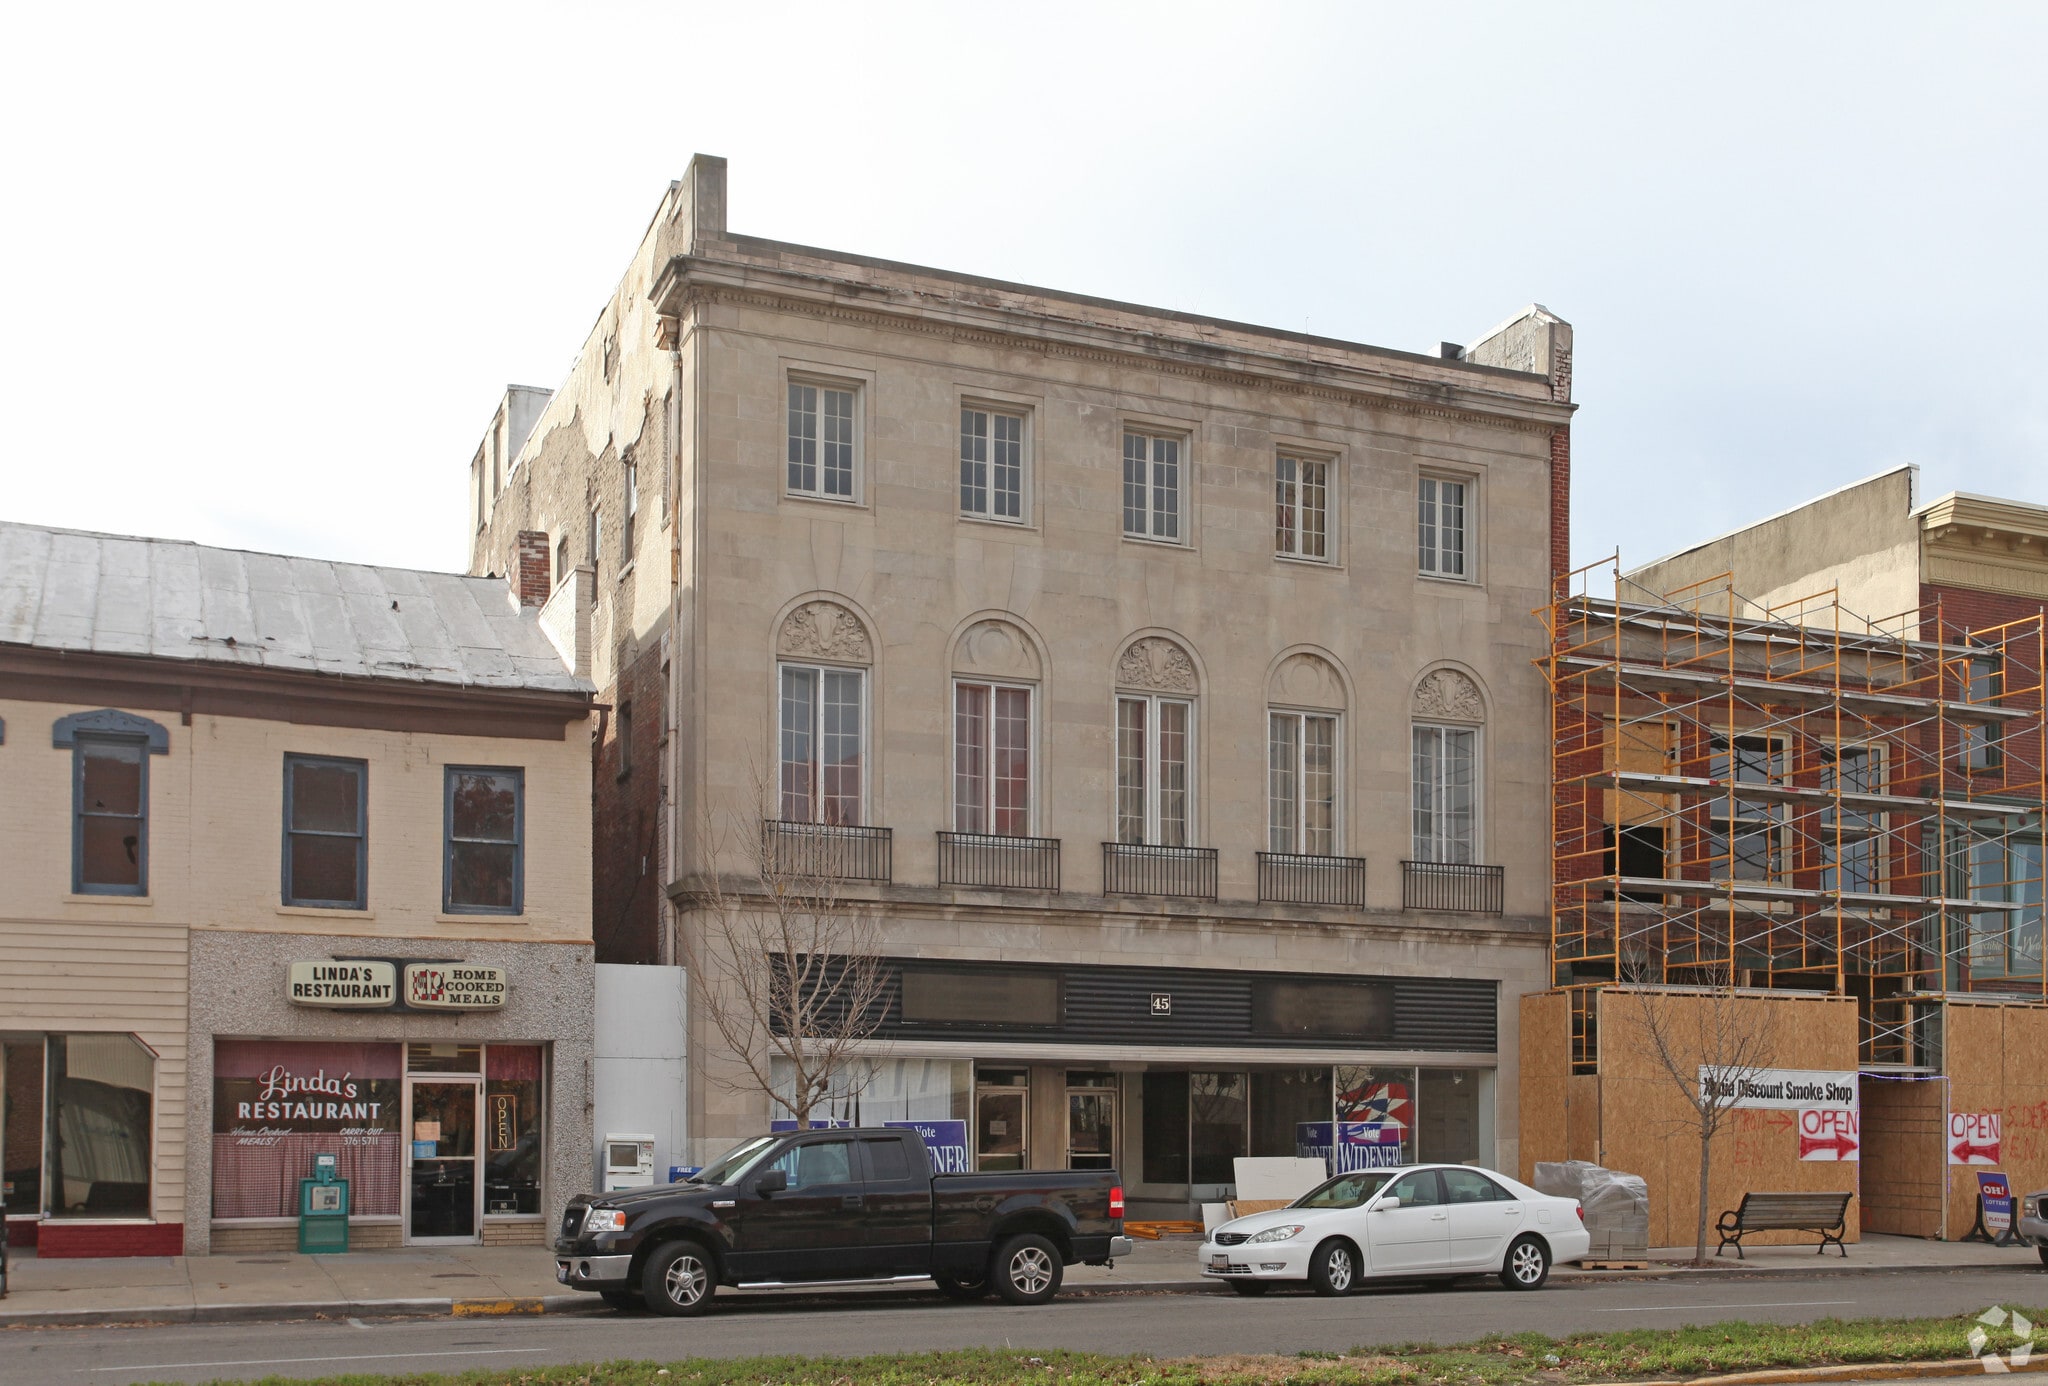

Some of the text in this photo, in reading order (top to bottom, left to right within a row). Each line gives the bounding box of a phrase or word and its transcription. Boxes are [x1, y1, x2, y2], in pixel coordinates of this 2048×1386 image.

[313, 966, 373, 981] LINDA'S
[453, 969, 497, 981] HOME
[293, 983, 391, 999] RESTAURANT
[445, 982, 505, 993] COOKED
[449, 994, 501, 1006] MEALS
[1153, 998, 1169, 1010] 45
[258, 1065, 358, 1101] Linda's
[1738, 1079, 1784, 1100] Discount
[1786, 1081, 1824, 1101] Smoke
[1825, 1082, 1853, 1105] Shop
[238, 1102, 381, 1120] RESTAURANT
[497, 1097, 508, 1149] OPEN
[1801, 1110, 1858, 1135] OPEN
[1951, 1113, 2000, 1139] OPEN
[257, 1126, 292, 1137] Cooked
[339, 1127, 384, 1136] CARRY-OUT
[914, 1125, 936, 1138] Vote
[1306, 1127, 1318, 1138] Vote
[1363, 1126, 1380, 1139] Vote
[1340, 1142, 1400, 1173] WIDENER
[1983, 1185, 2005, 1196] OH!
